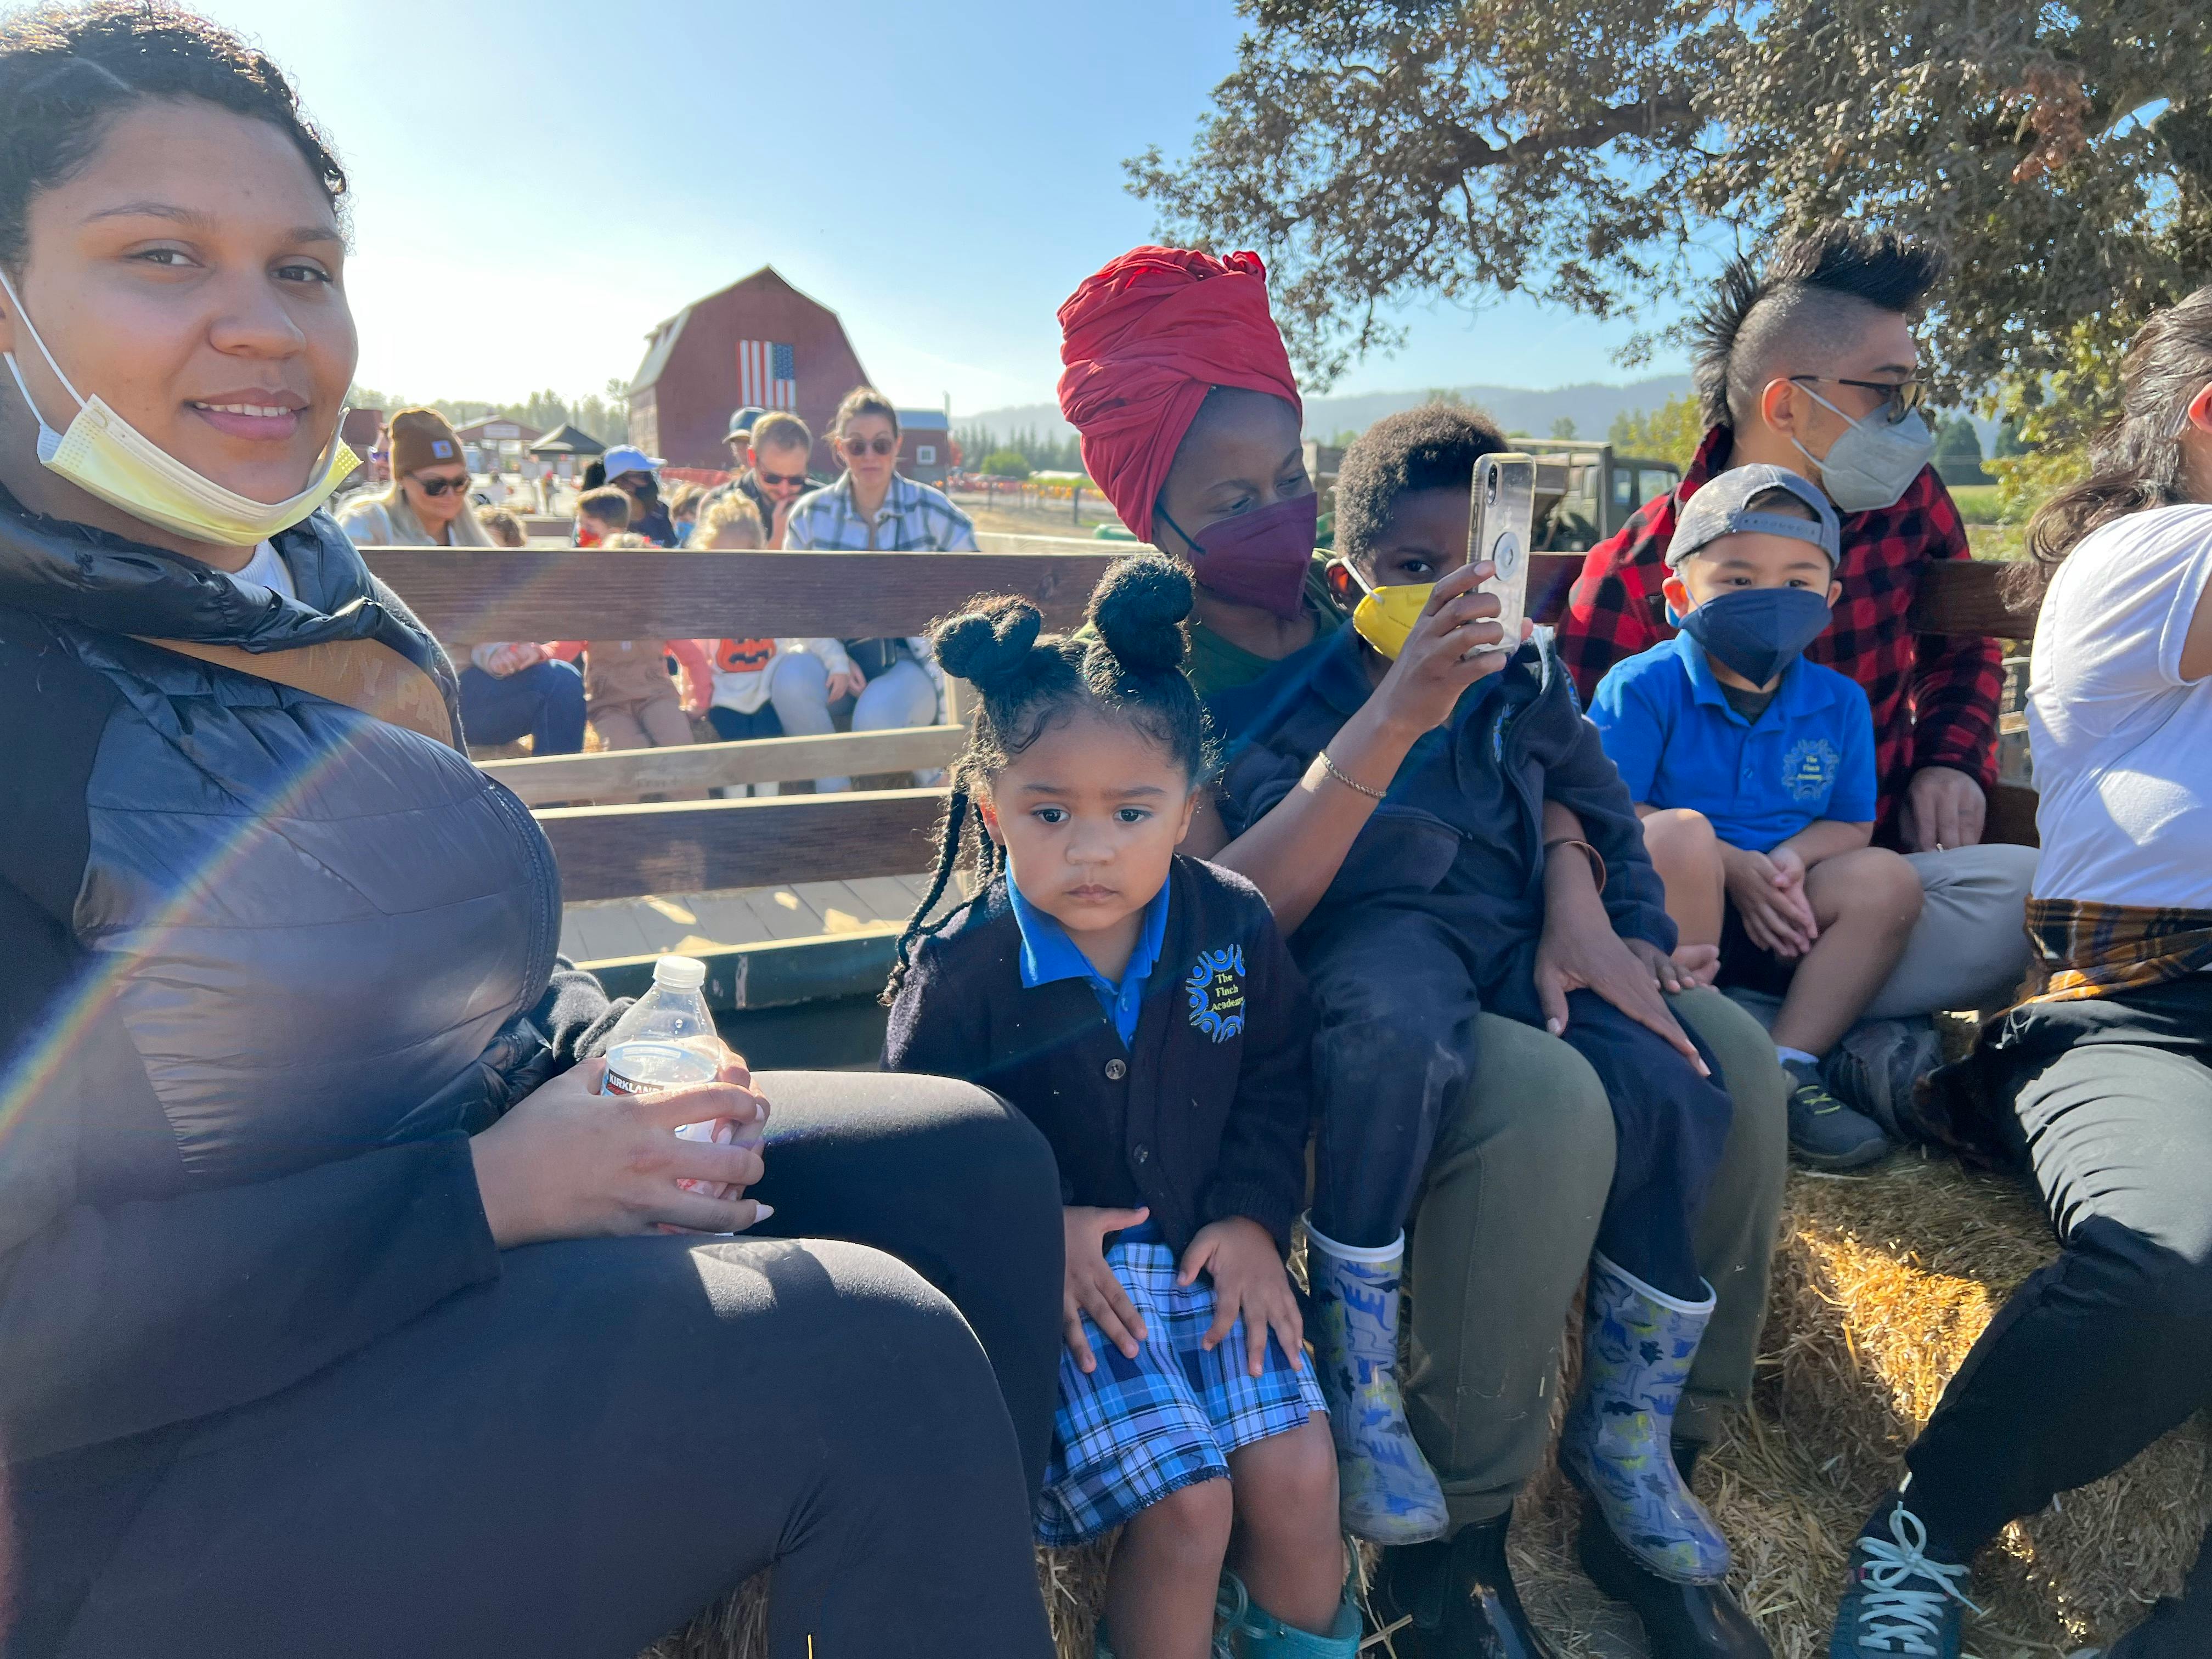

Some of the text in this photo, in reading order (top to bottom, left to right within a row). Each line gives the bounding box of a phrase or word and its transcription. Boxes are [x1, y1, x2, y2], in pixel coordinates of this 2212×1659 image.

[1215, 973, 1233, 984] The
[1215, 984, 1239, 997] Finch
[1211, 996, 1244, 1011] Academy
